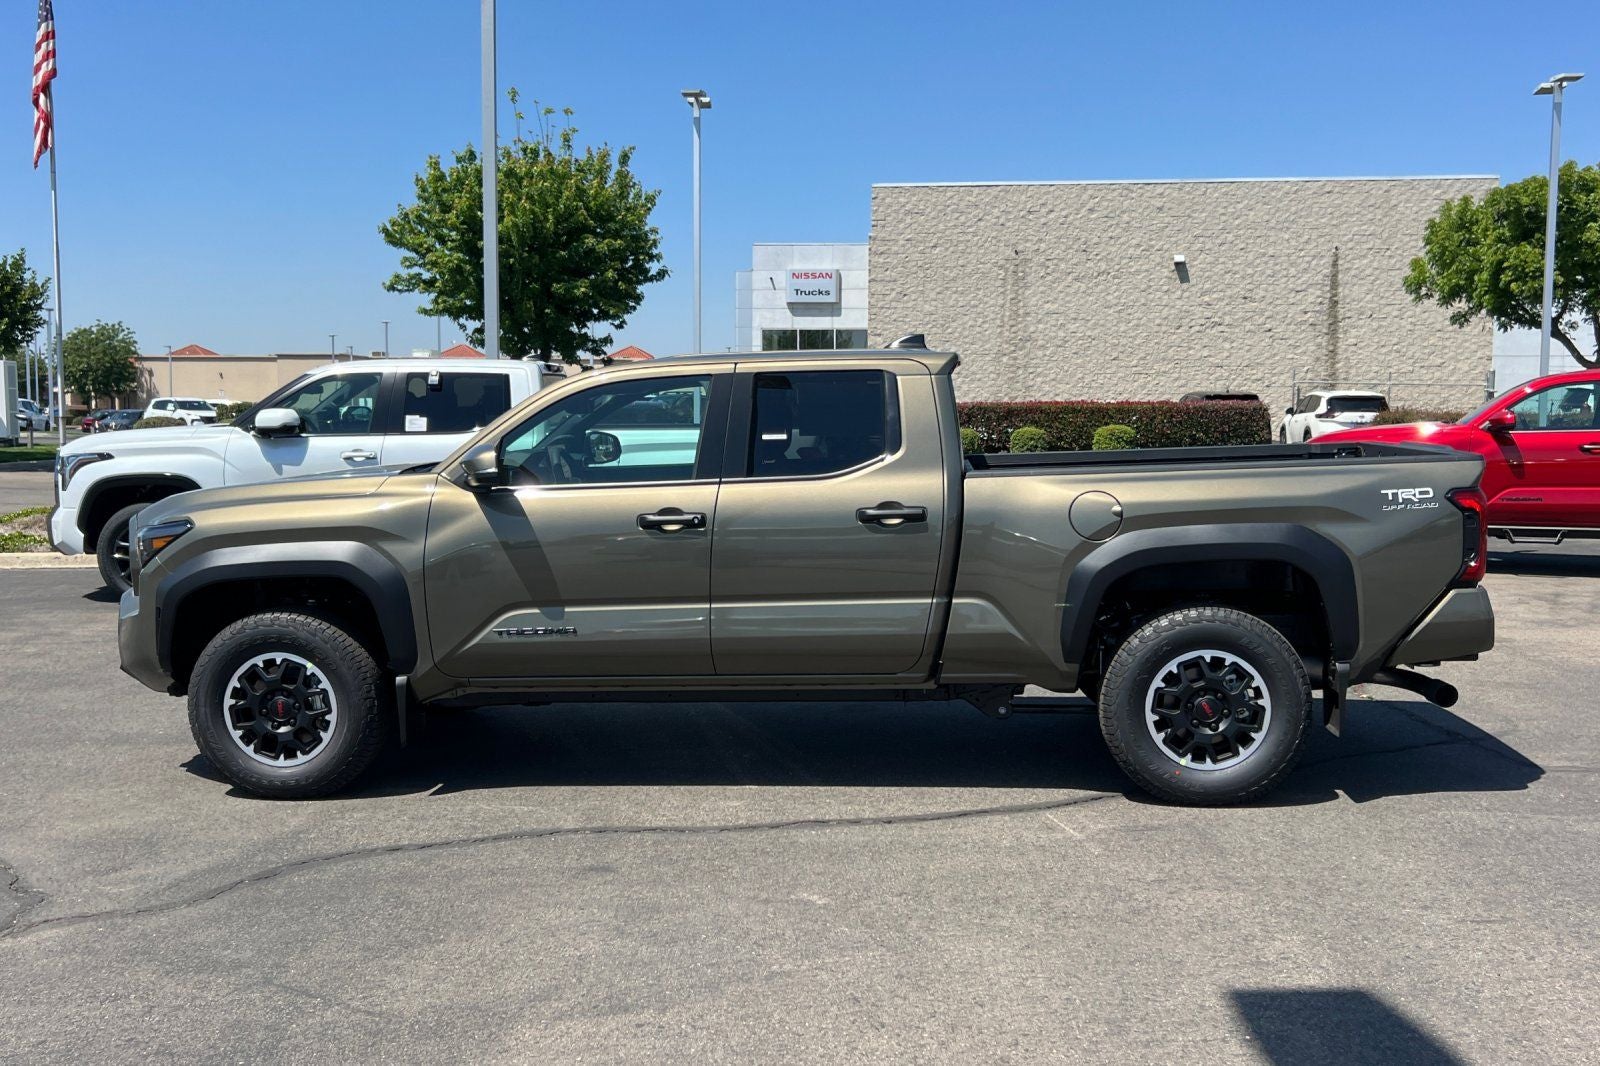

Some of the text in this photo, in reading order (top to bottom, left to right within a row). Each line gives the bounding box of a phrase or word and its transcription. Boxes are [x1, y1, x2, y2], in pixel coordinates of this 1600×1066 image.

[793, 288, 831, 296] Trucks
[1380, 487, 1434, 503] TRD
[492, 626, 578, 637] TACOMA
